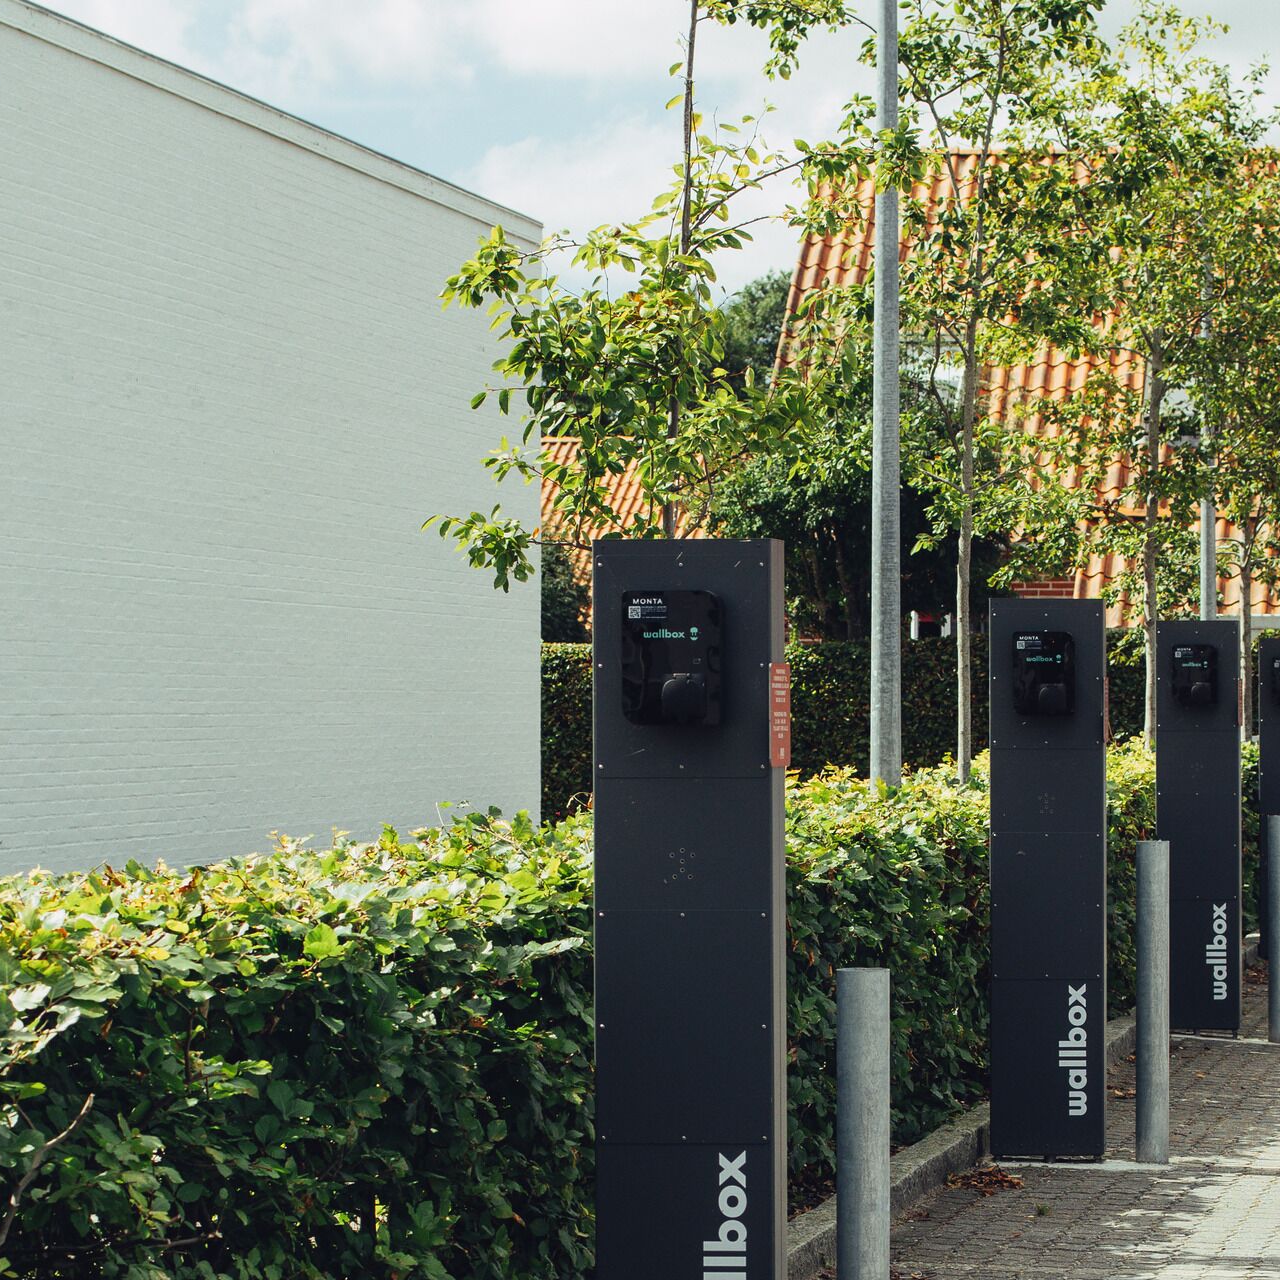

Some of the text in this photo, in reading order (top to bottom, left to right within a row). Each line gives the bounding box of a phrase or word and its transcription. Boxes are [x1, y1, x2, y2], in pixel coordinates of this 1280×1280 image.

[643, 628, 685, 638] wallbox
[1206, 902, 1227, 1001] wallbox
[1058, 983, 1088, 1117] wallbox
